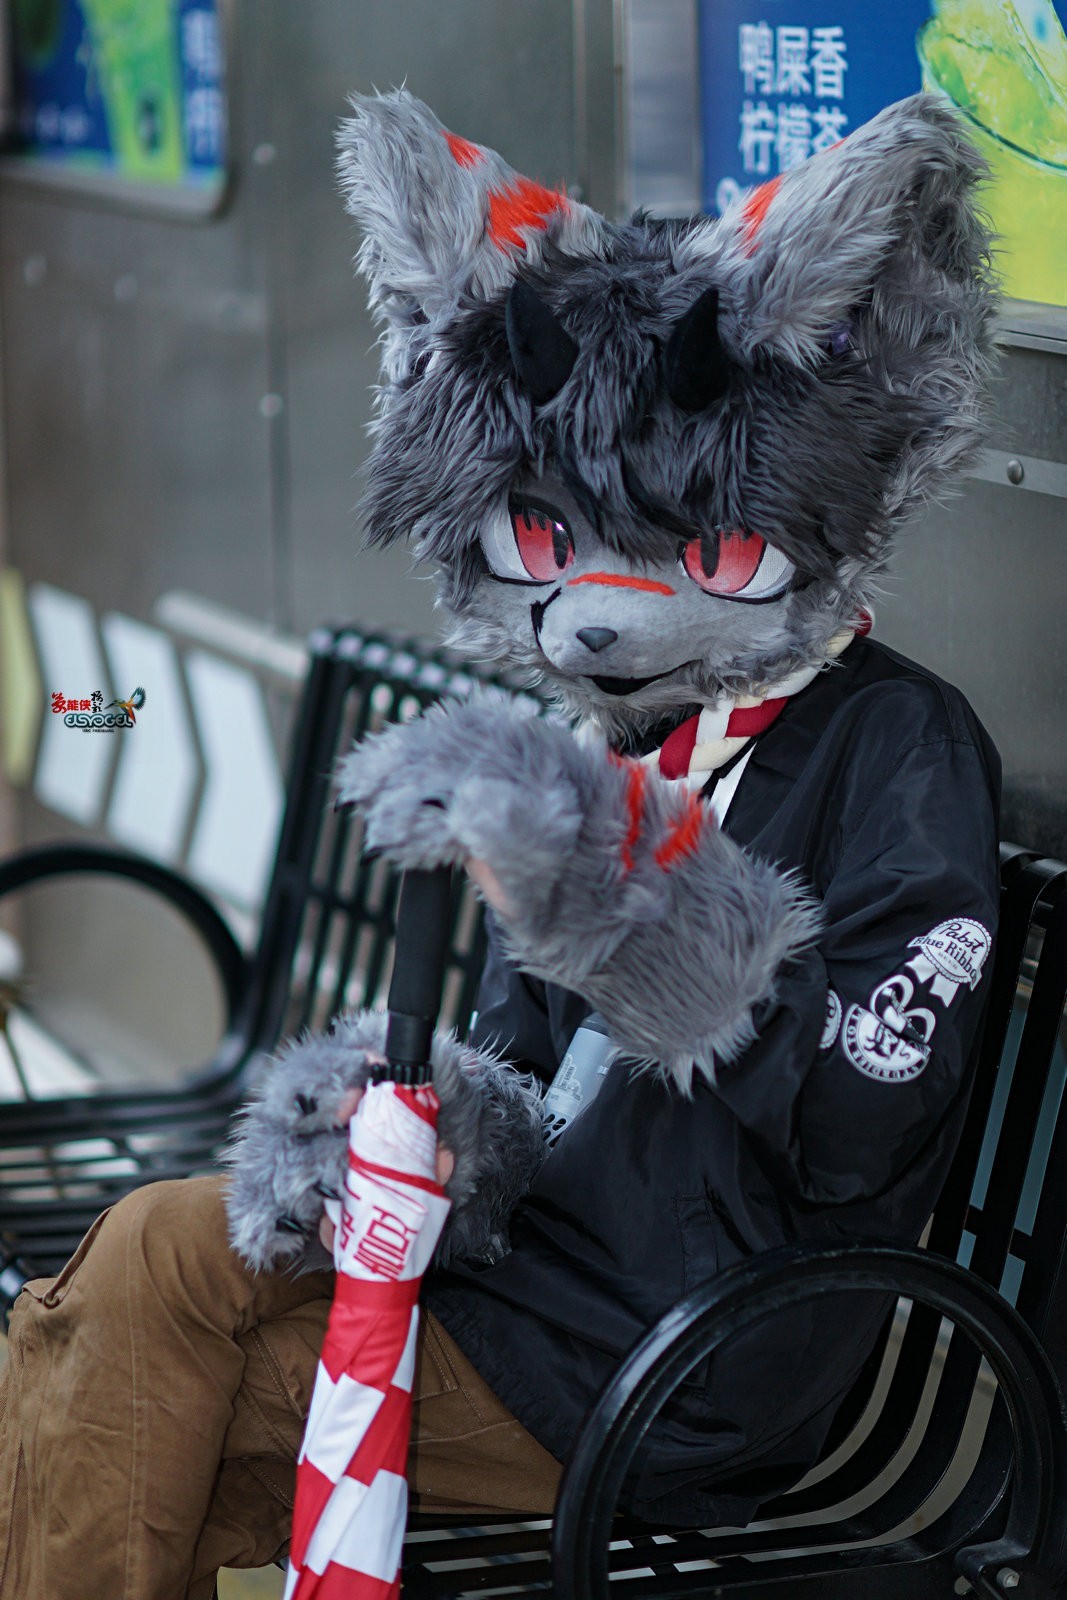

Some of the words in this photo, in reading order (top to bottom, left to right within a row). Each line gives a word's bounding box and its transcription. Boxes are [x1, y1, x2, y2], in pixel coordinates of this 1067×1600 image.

[738, 21, 848, 99] 鸭屎香
[738, 101, 848, 174] 柠檬茶
[939, 922, 985, 954] Pabst
